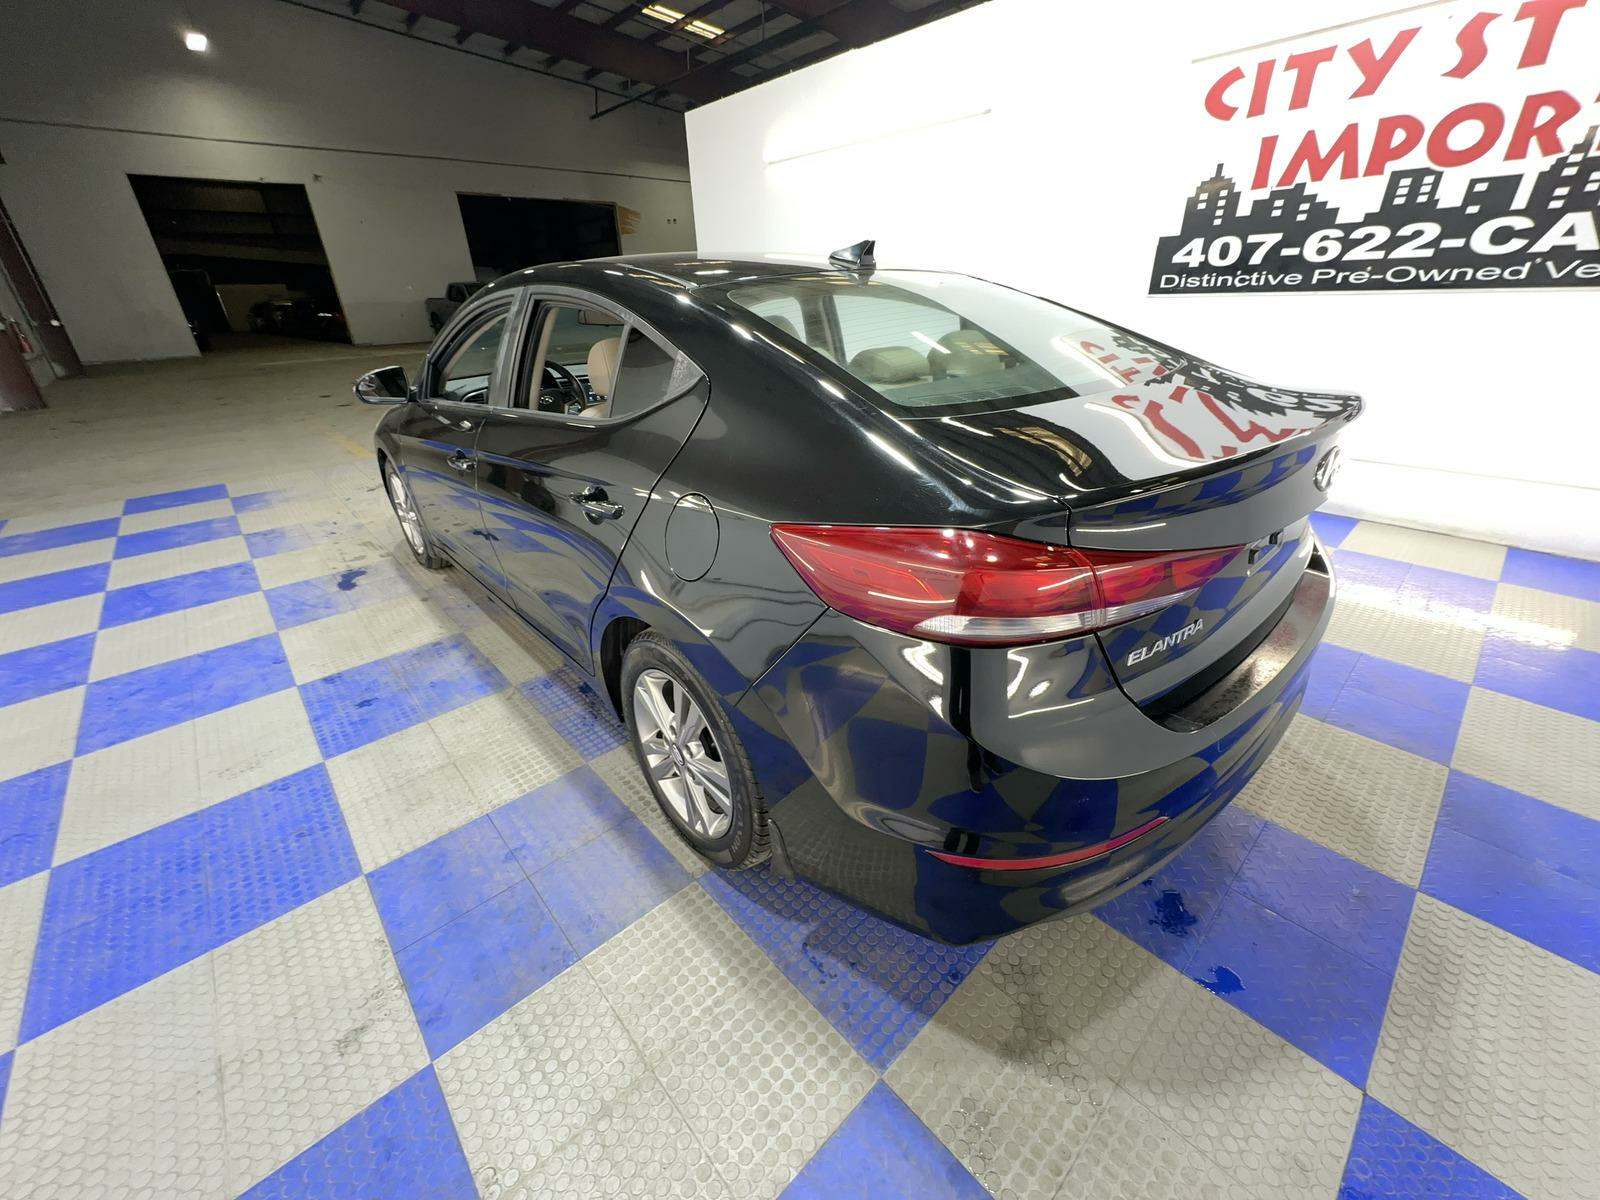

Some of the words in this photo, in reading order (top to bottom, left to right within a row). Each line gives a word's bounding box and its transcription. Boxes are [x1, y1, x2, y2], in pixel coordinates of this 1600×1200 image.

[1204, 26, 1422, 121] CITY
[1250, 90, 1600, 190] IMPOR
[1160, 270, 1302, 288] Distinctive
[1311, 261, 1532, 284] Pre-Owned
[1127, 618, 1204, 667] ELANTRA
